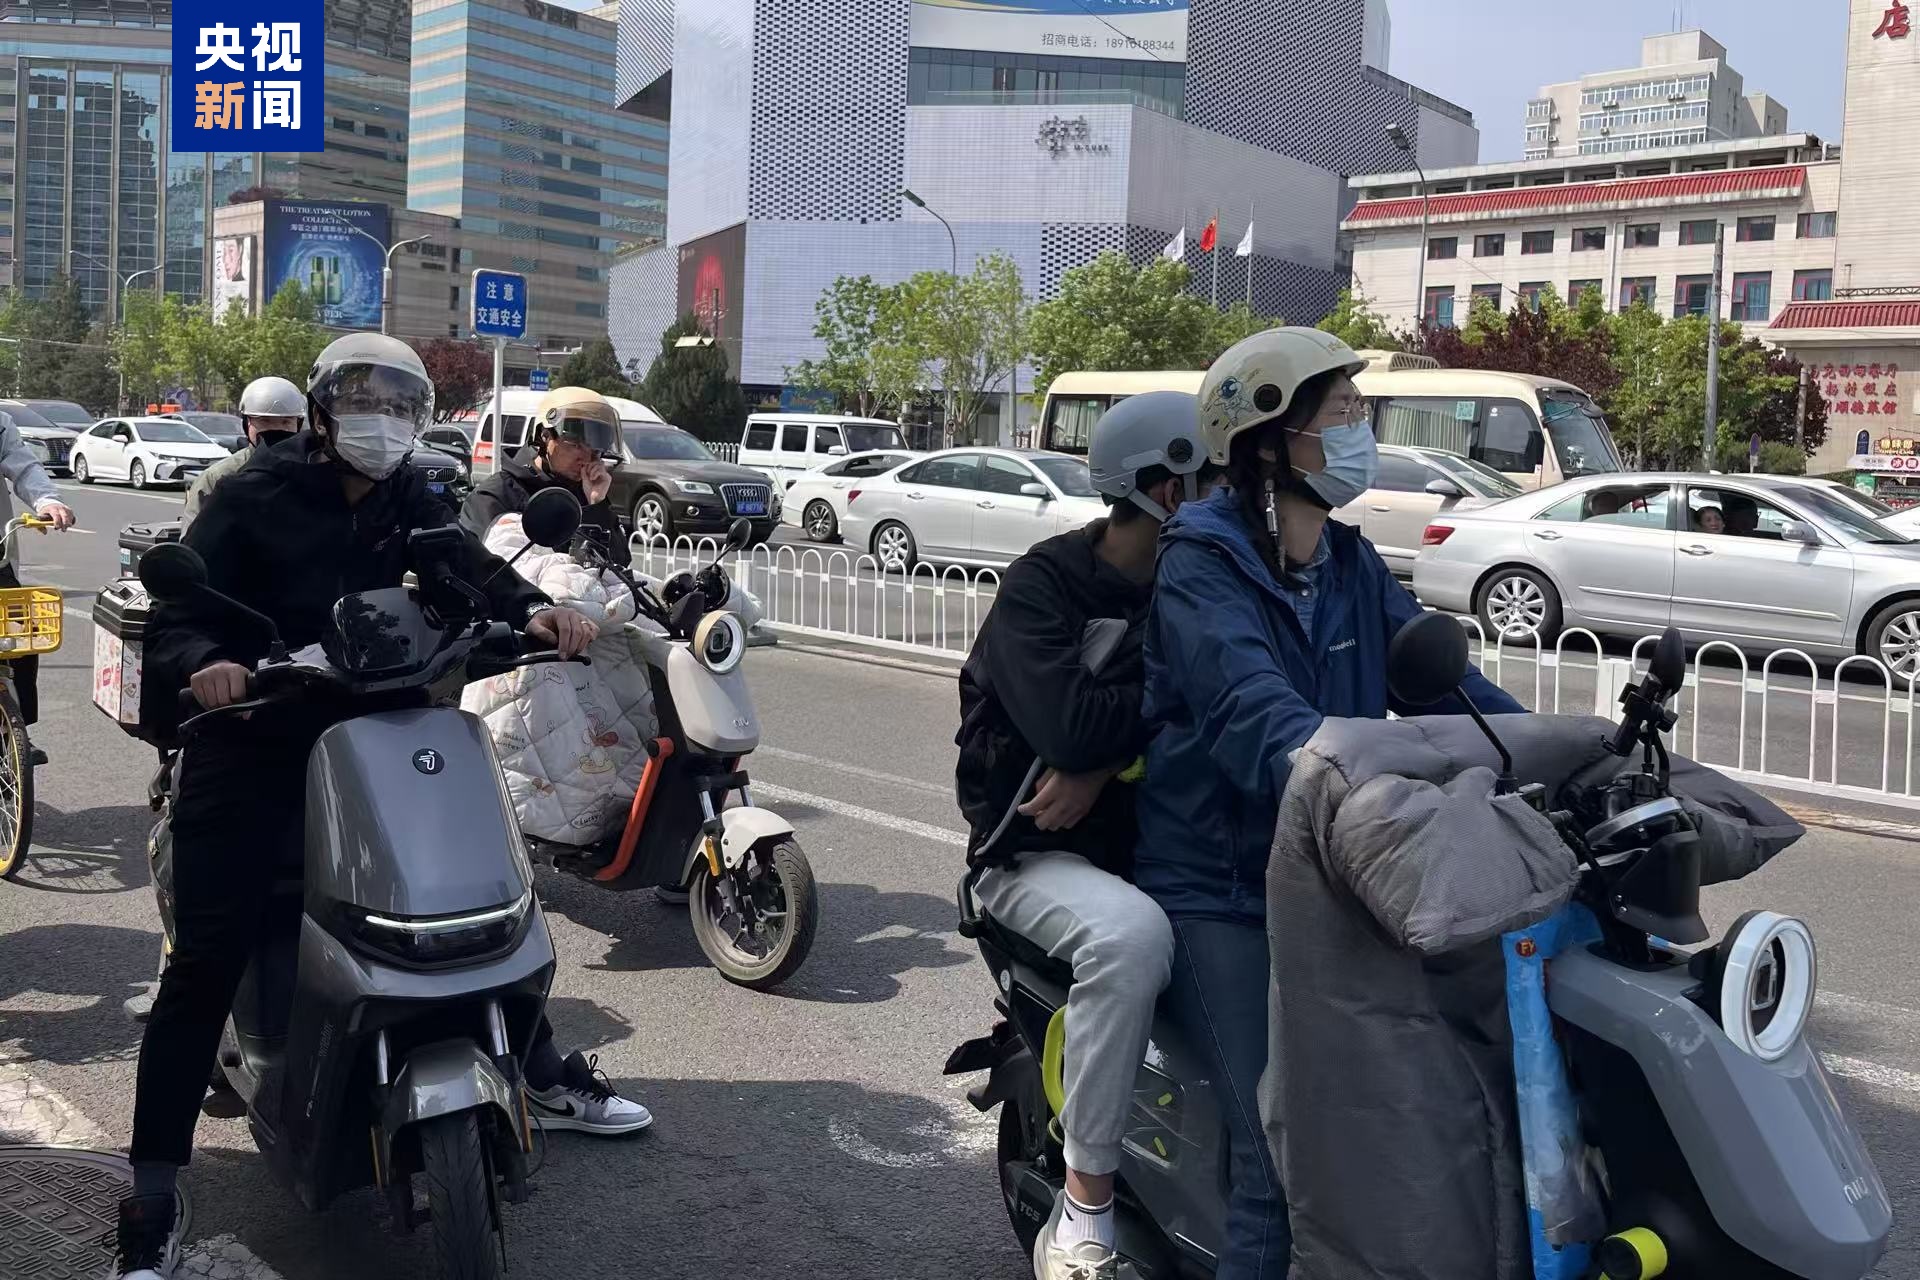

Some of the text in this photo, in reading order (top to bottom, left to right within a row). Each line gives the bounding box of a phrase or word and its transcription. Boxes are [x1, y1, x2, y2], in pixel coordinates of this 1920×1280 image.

[1872, 0, 1910, 40] 店
[1105, 37, 1175, 50] 18910188344
[280, 205, 371, 217] THE TREATMENT LOTION
[486, 281, 514, 302] 注意
[477, 306, 522, 328] 交通安全
